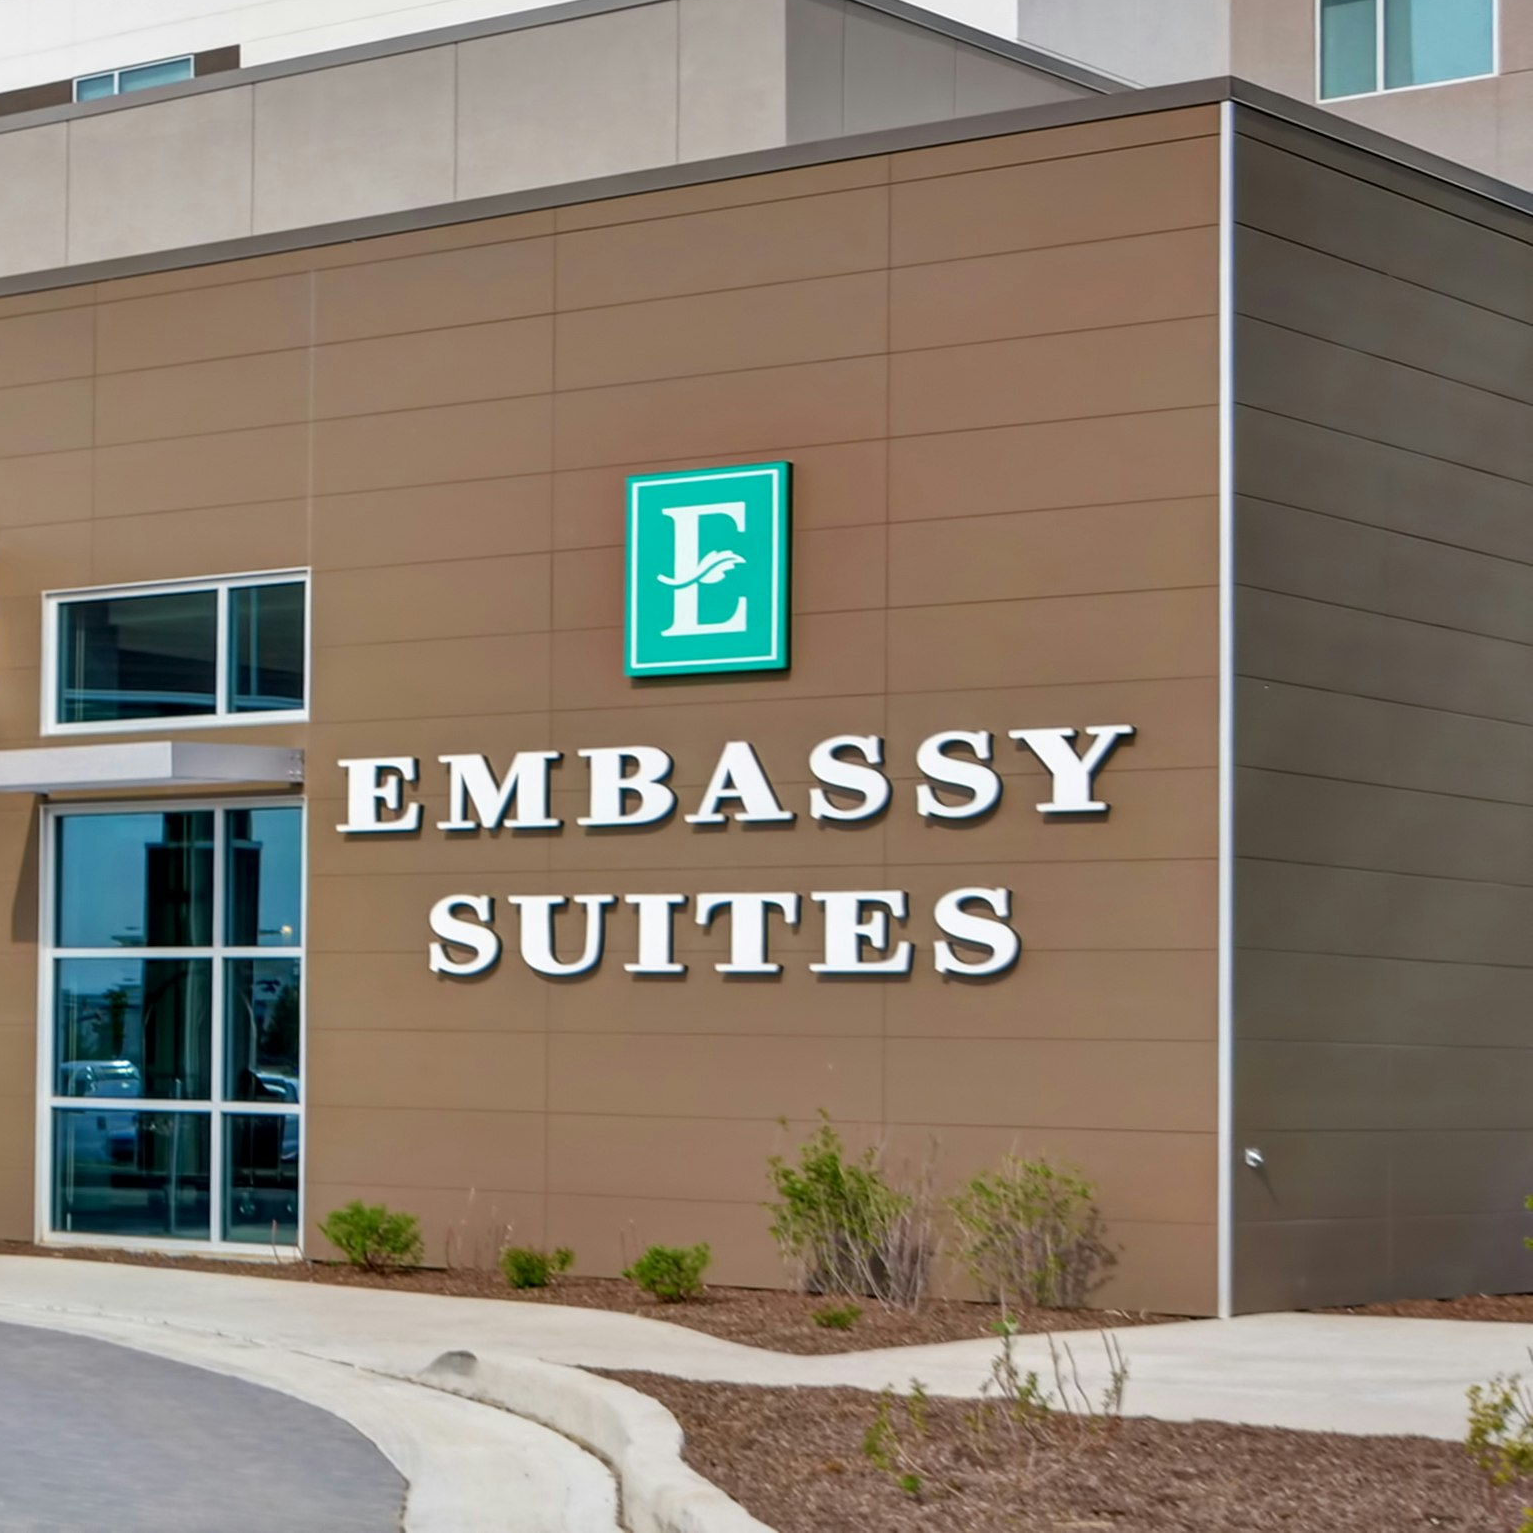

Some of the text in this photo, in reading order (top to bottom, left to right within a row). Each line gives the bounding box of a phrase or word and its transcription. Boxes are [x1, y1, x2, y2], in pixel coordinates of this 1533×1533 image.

[656, 500, 748, 637] E
[334, 723, 1137, 837] EMBASSY
[428, 885, 1024, 981] SUITES
